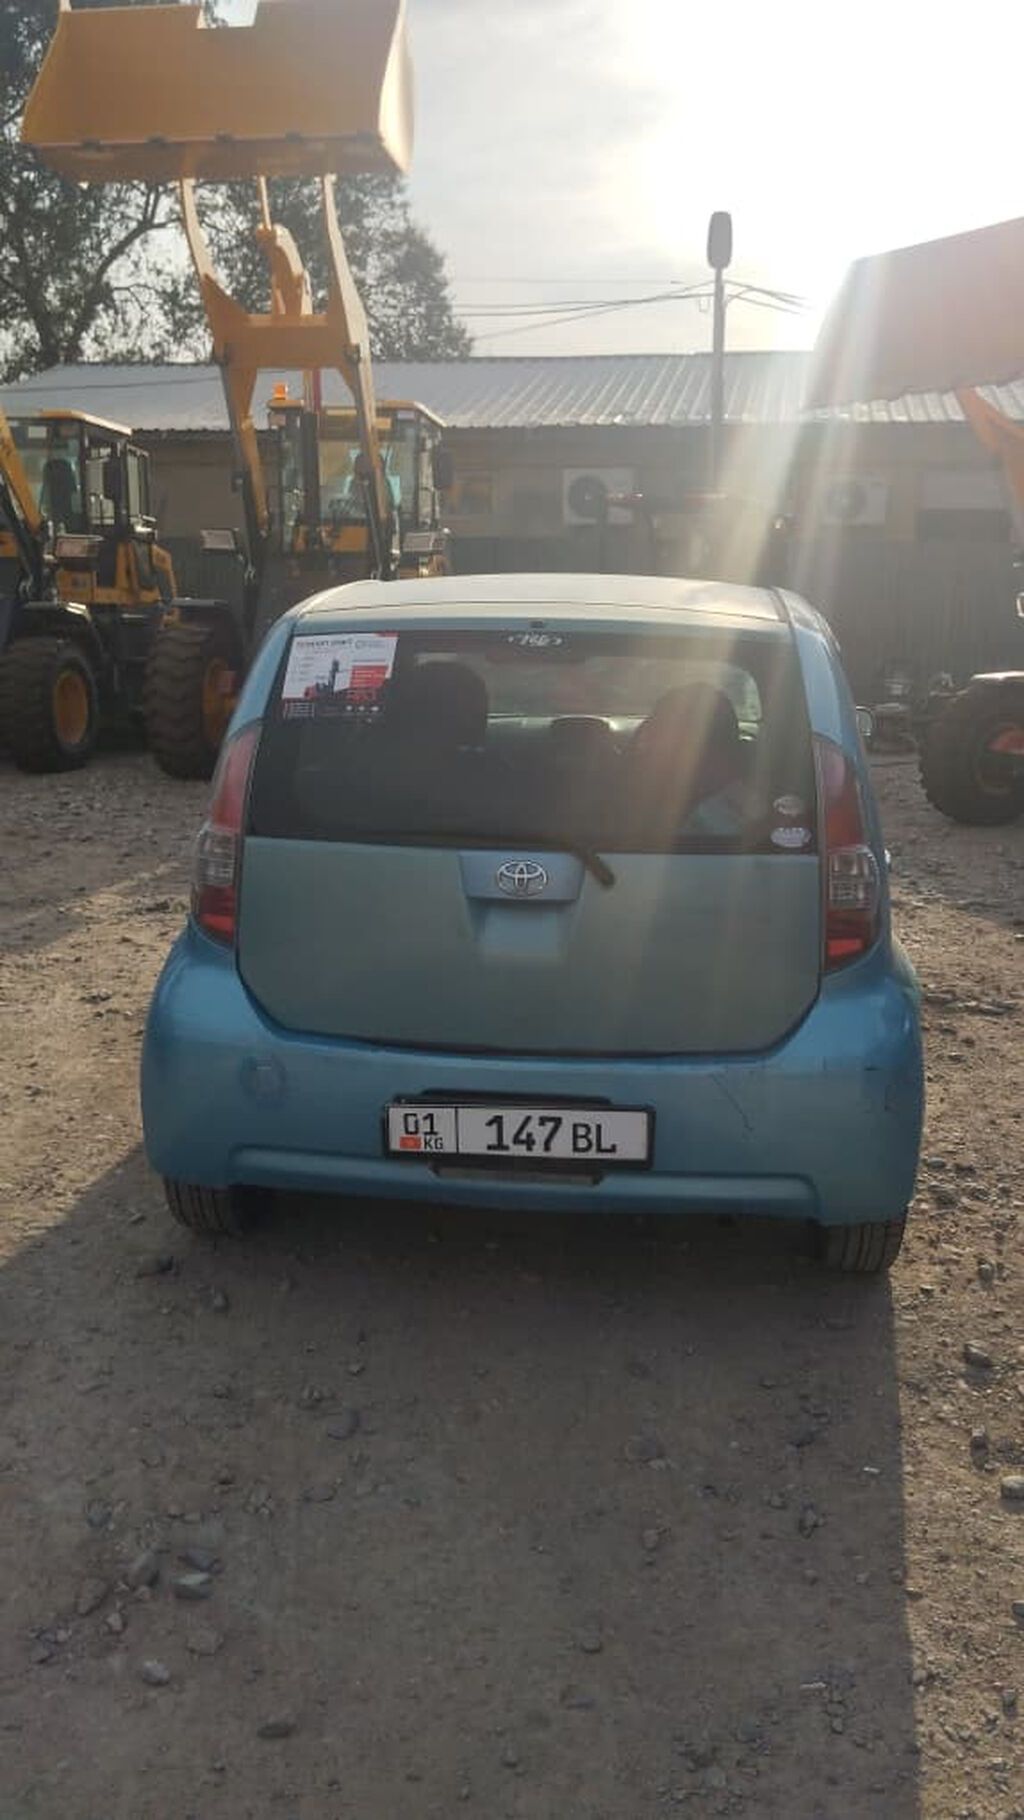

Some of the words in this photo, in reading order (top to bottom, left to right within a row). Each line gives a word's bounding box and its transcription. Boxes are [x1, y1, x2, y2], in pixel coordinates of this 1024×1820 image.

[403, 1112, 438, 1136] 01
[485, 1115, 563, 1152] 147
[571, 1123, 617, 1154] BL
[424, 1136, 443, 1150] KG
